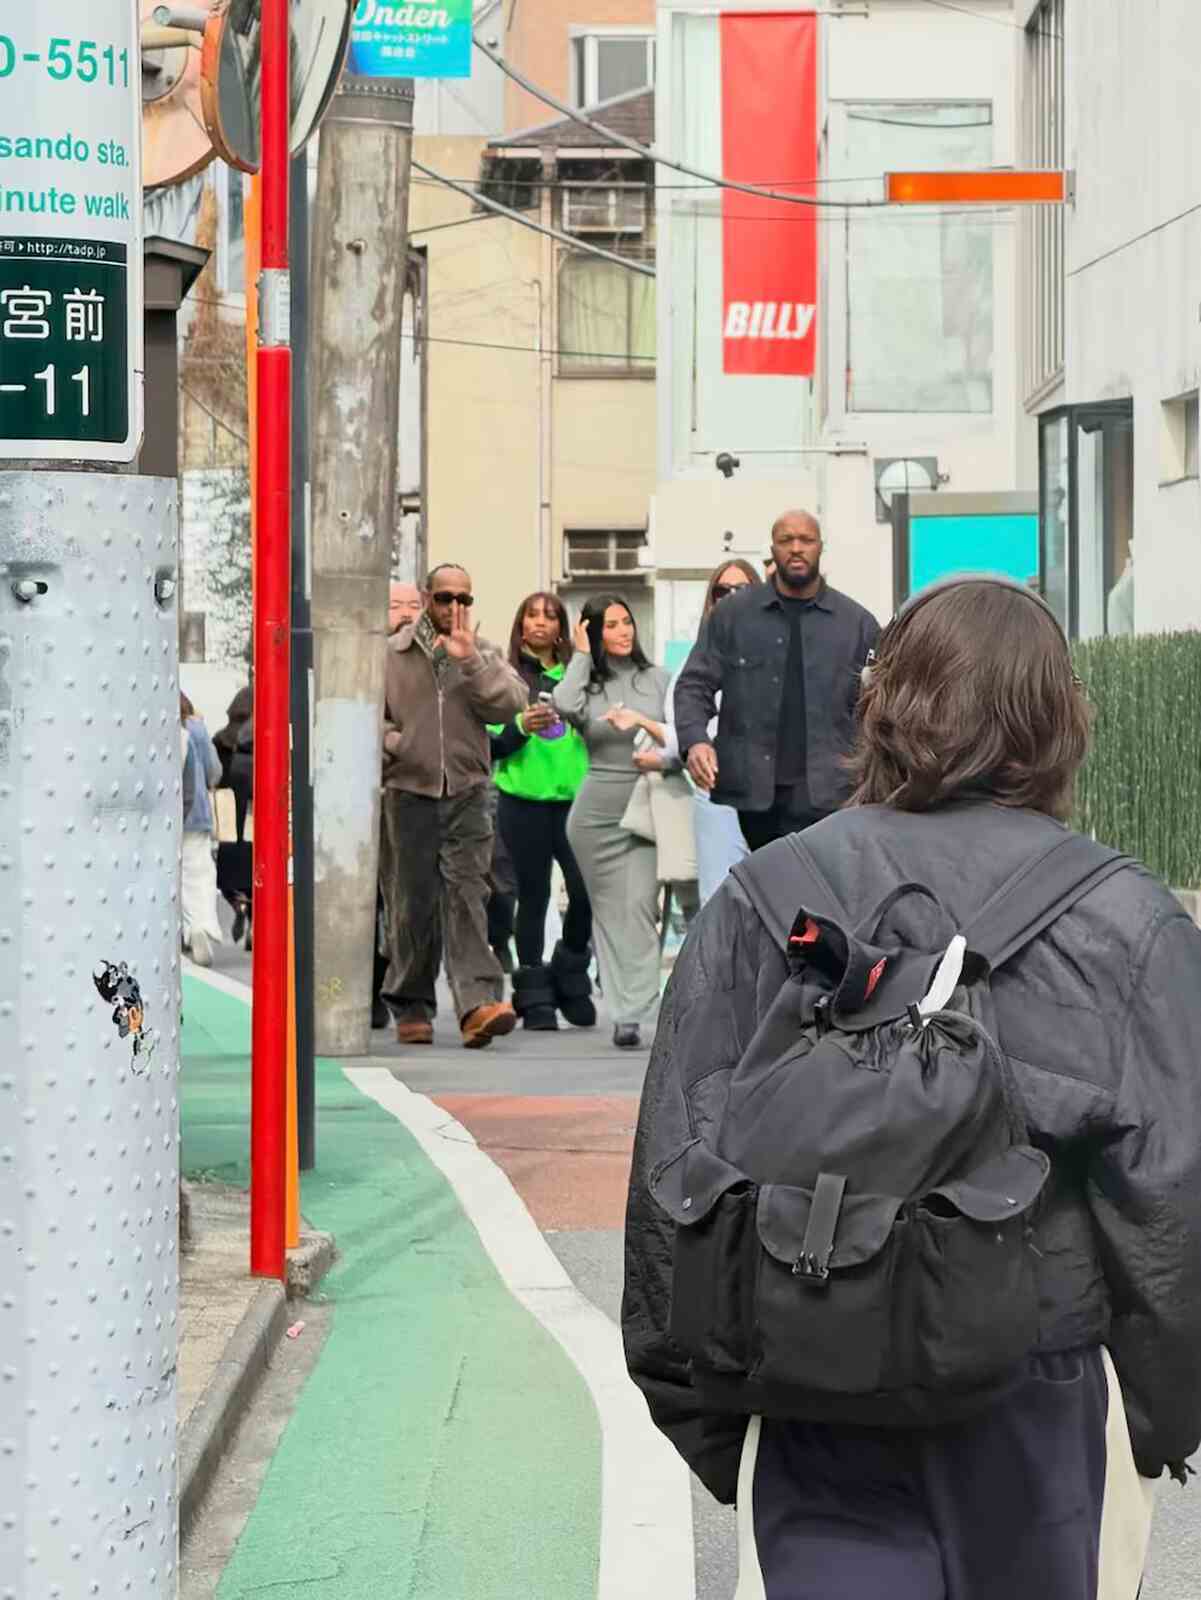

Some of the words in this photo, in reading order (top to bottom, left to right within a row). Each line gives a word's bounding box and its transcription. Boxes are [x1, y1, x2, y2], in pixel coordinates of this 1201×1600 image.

[0, 133, 89, 162] sando
[97, 139, 128, 167] sta.
[0, 187, 76, 214] nute
[84, 192, 129, 219] walk
[0, 240, 15, 253] 可
[27, 241, 106, 259] http://tadp.jp
[0, 284, 105, 342] 宮前
[723, 301, 817, 339] BILLY
